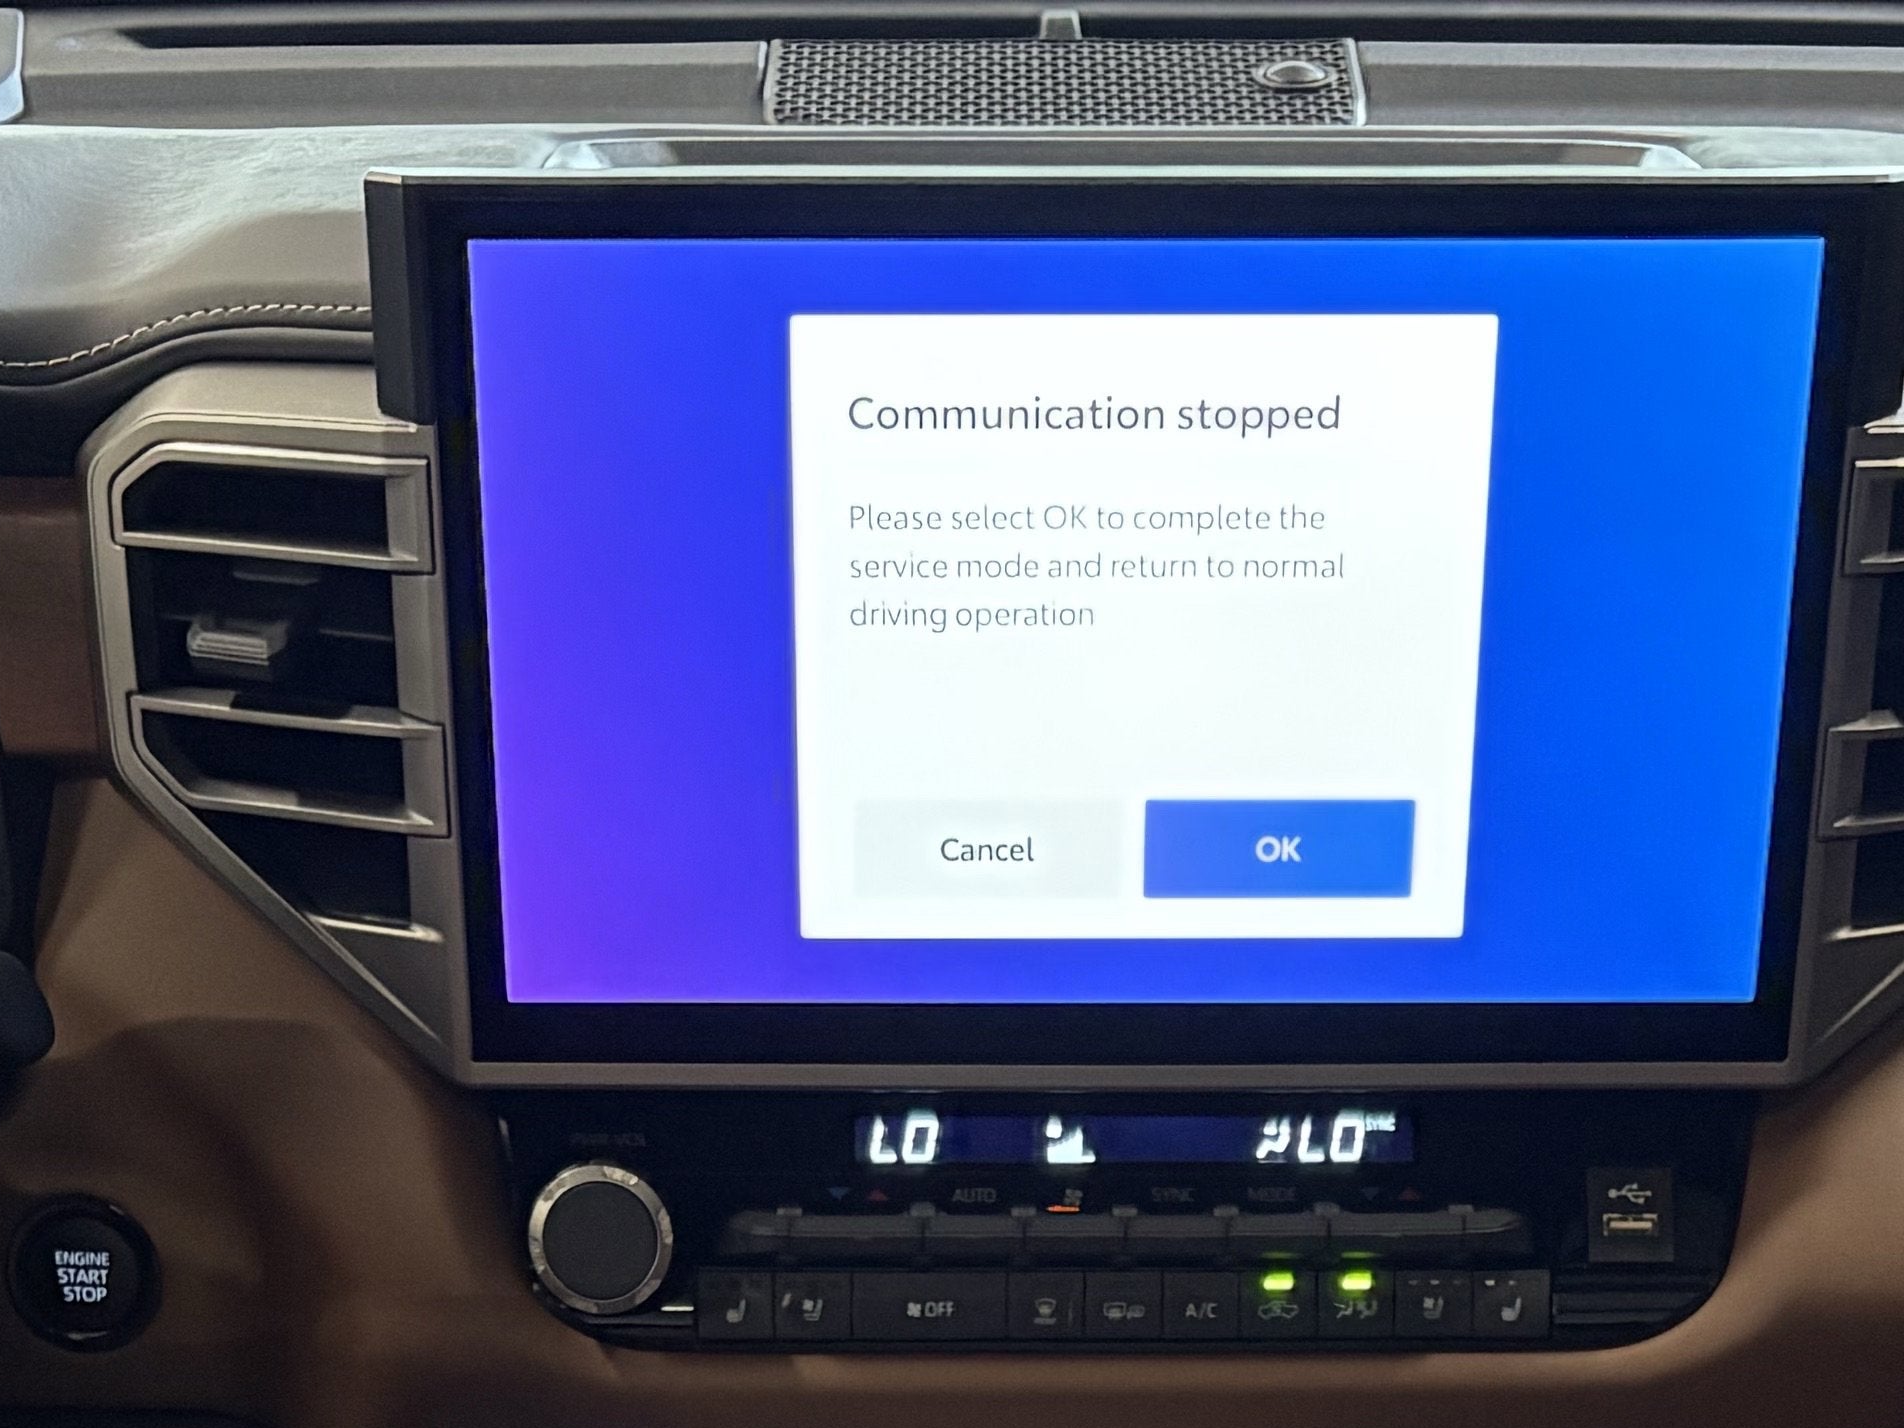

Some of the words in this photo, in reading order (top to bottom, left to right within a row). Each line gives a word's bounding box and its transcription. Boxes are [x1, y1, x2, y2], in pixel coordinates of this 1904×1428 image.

[848, 395, 1165, 432] Communication
[1177, 395, 1341, 438] stopped
[849, 505, 943, 532] Please
[951, 505, 1034, 532] select
[1043, 505, 1088, 532] OK
[1097, 507, 1125, 532] to
[1133, 505, 1271, 536] complete
[1279, 505, 1326, 532] the
[849, 552, 948, 580] service
[956, 553, 1039, 580] mode
[1048, 553, 1102, 580] and
[1111, 555, 1197, 580] return
[1206, 556, 1234, 580] to
[1243, 553, 1345, 580] normal
[849, 601, 947, 633] driving
[955, 603, 1094, 633] operation
[940, 837, 1035, 864] Cancel
[1255, 836, 1302, 864] OK
[868, 1109, 940, 1164] LO
[1297, 1110, 1365, 1164] LO
[953, 1188, 997, 1204] AUTO
[54, 1250, 111, 1267] ENGINE
[56, 1268, 109, 1285] START
[63, 1286, 108, 1303] STOP
[924, 1301, 955, 1318] OFF
[1185, 1303, 1218, 1319] A/C
